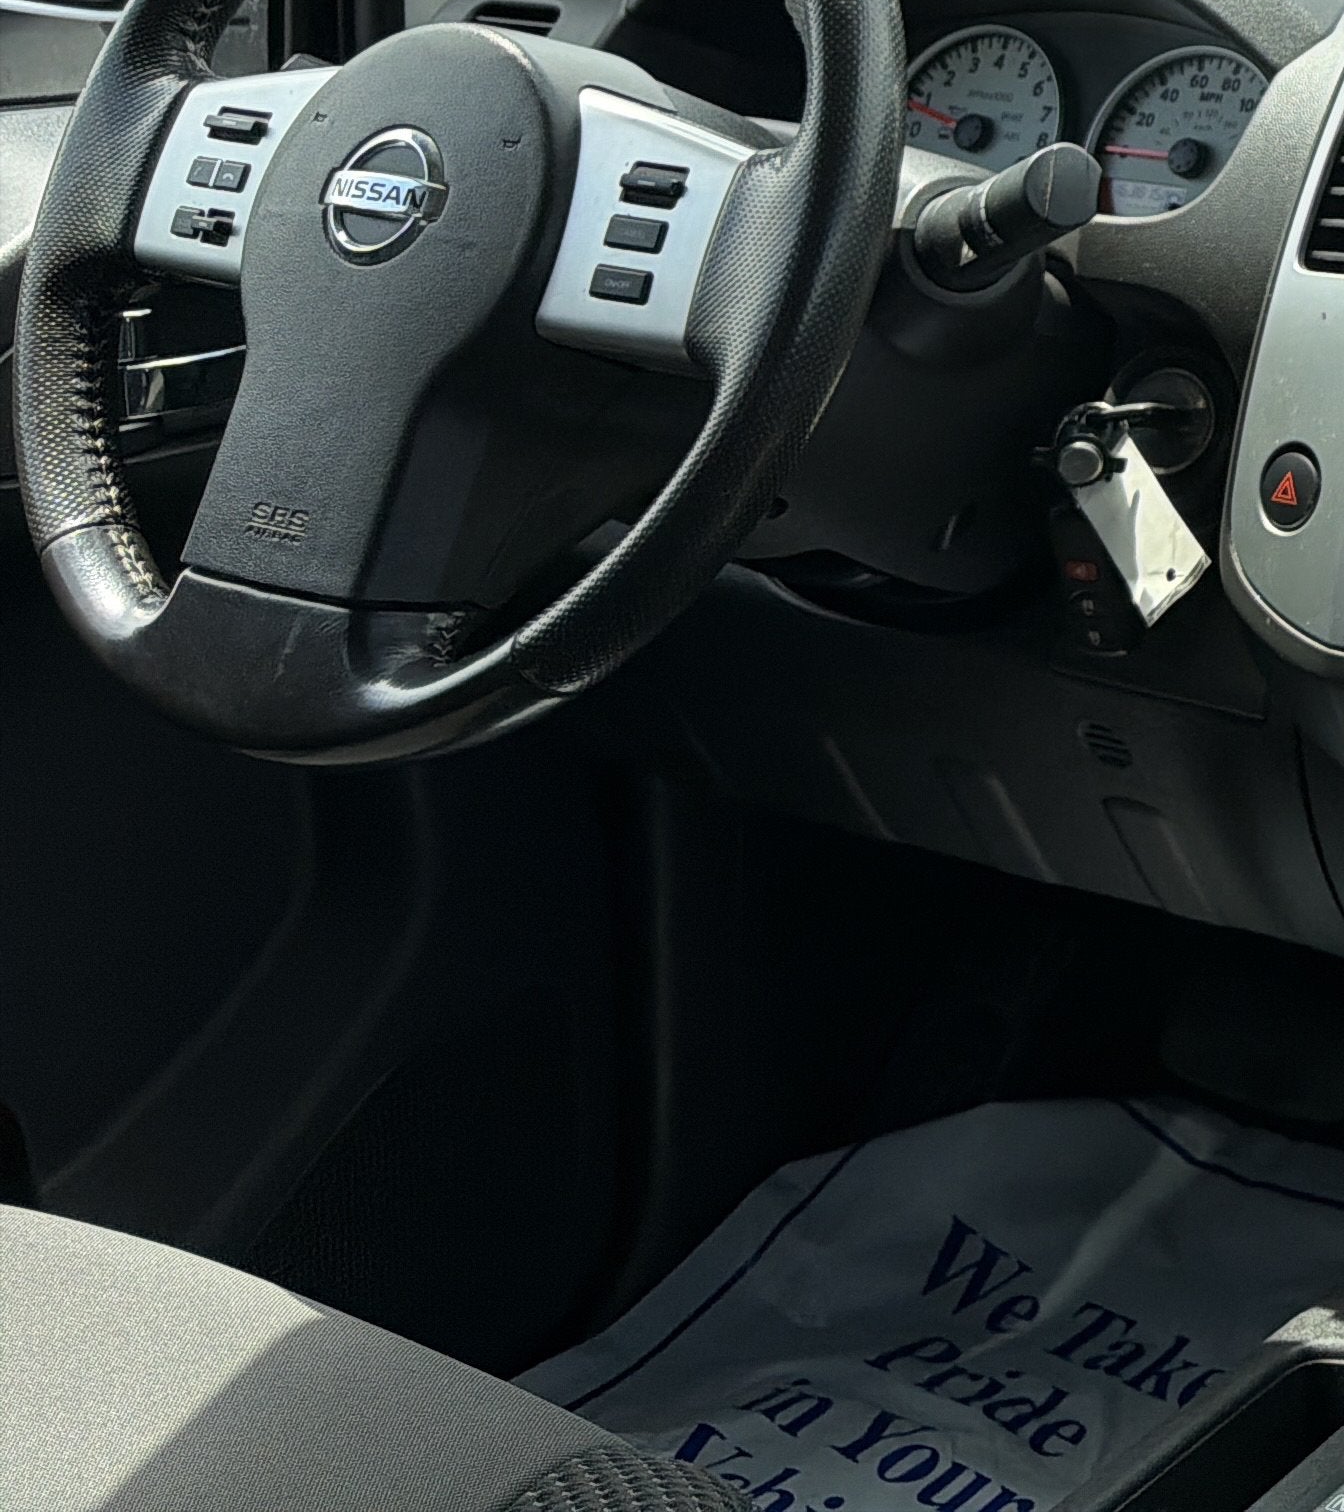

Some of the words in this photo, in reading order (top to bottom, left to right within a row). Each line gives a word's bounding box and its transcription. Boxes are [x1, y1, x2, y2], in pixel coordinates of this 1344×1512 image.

[967, 55, 980, 74] 3
[992, 53, 1007, 72] 4
[1017, 60, 1031, 80] 5
[942, 70, 956, 88] 2
[1032, 78, 1046, 98] 6
[1190, 74, 1210, 89] 60
[1221, 77, 1241, 92] 80
[1160, 88, 1180, 103] 40
[1199, 90, 1224, 104] MPH
[1038, 105, 1055, 123] 7
[1135, 111, 1155, 127] 20
[330, 178, 428, 210] NISSAN
[252, 501, 310, 528] SRS
[922, 1215, 1045, 1334] We
[865, 1335, 1088, 1460] Pride
[738, 1376, 833, 1438] in
[834, 1416, 1036, 1512] Your
